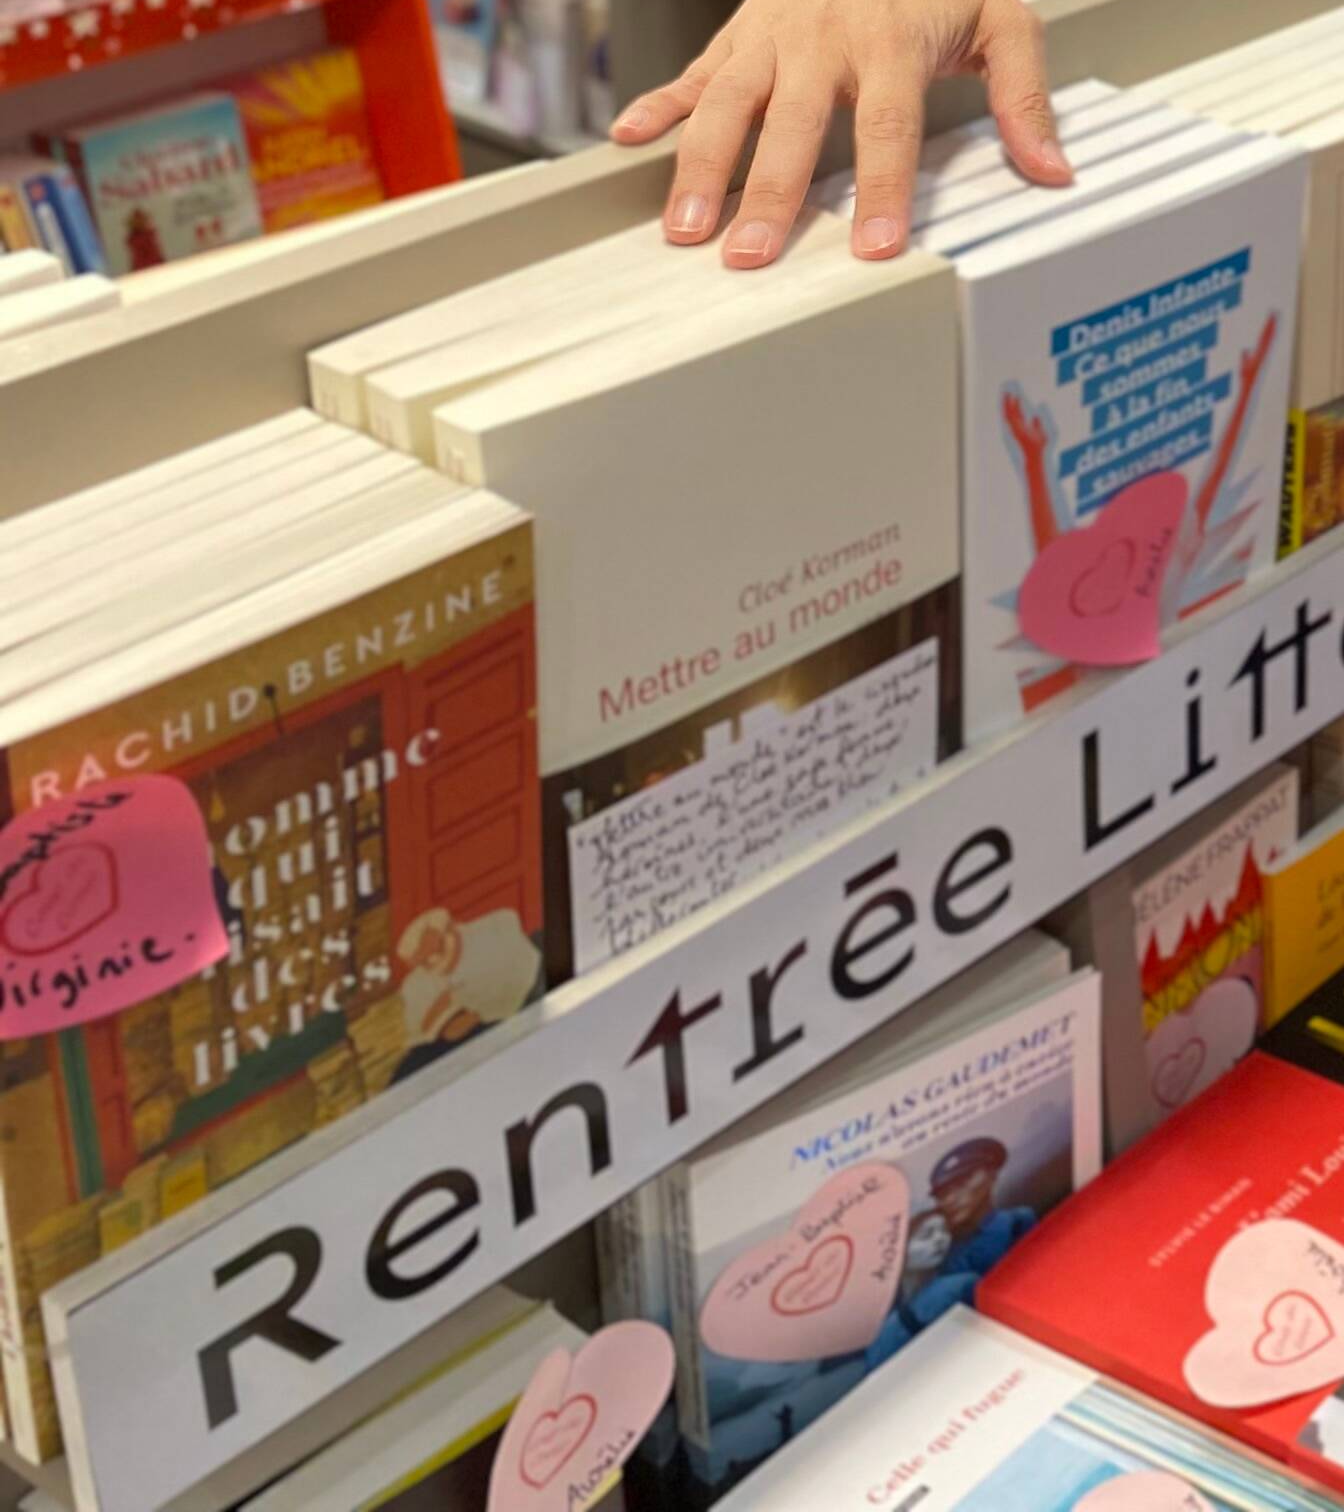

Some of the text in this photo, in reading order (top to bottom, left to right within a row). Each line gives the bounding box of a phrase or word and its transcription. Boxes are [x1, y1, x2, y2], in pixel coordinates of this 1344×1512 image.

[1068, 264, 1237, 351] Denis Infante
[1074, 302, 1228, 382] Ce que nous
[1099, 344, 1206, 402] sommes
[1128, 385, 1154, 423] la
[1156, 374, 1194, 412] fin
[1076, 393, 1218, 473] des enfants
[736, 522, 901, 614] Cloé Korman
[597, 555, 904, 724] Mettre au monde
[28, 574, 505, 809] RACHID BENZINE
[224, 728, 442, 856] omme
[226, 816, 341, 910] qui
[200, 860, 378, 980] isait
[230, 928, 351, 1014] des
[193, 955, 392, 1088] livres
[195, 823, 1014, 1436] Rentrée
[788, 1010, 1078, 1171] NICOLAS GAUDEMET
[865, 1452, 927, 1506] Celle
[927, 1419, 967, 1456] qui
